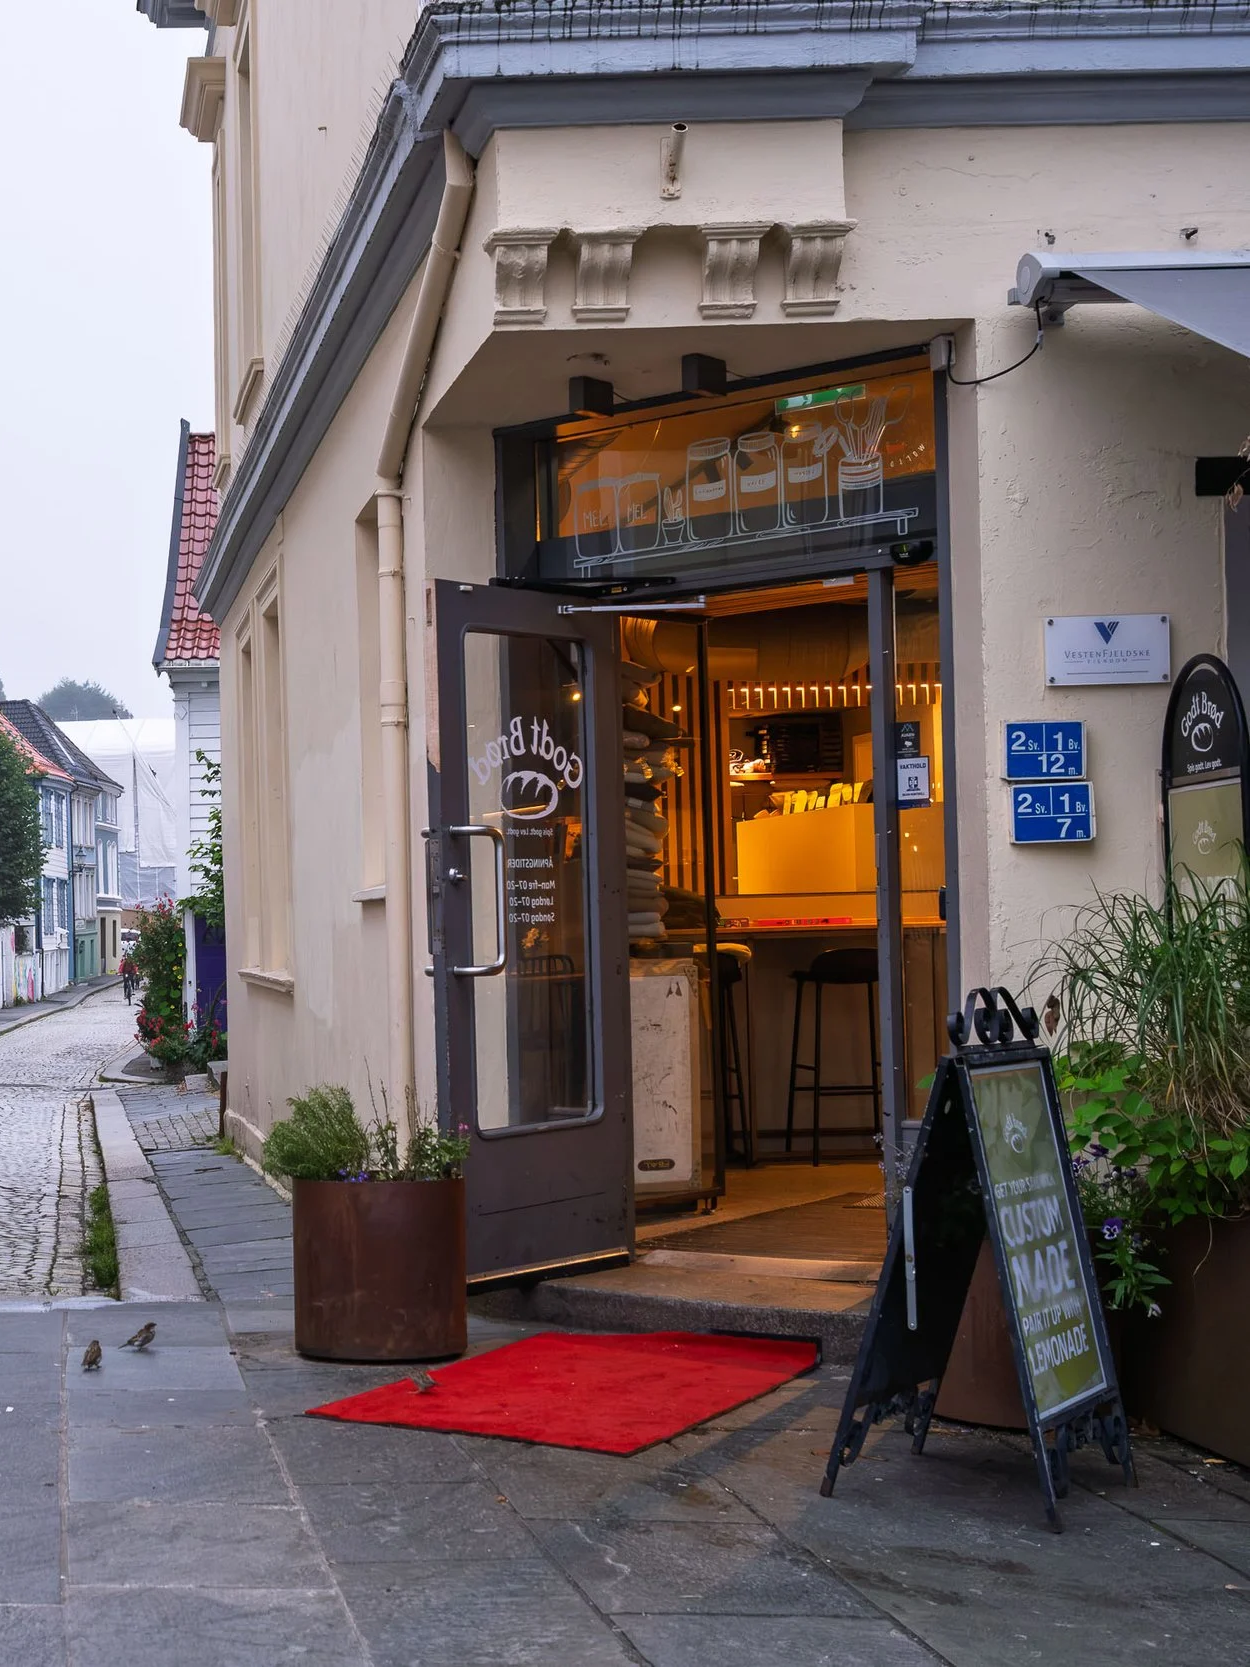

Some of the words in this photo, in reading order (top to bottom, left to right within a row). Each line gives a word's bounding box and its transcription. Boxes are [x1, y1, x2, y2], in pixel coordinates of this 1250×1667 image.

[1181, 692, 1200, 737] Godt
[1201, 691, 1224, 729] Brød
[1011, 731, 1026, 751] 2
[1028, 739, 1040, 751] Sv.
[1053, 731, 1063, 751] 1
[1068, 739, 1081, 750] Bv.
[1037, 753, 1065, 773] 12
[1068, 767, 1079, 775] m.
[1017, 793, 1033, 813] 2
[1035, 803, 1047, 814] Sv.
[1059, 793, 1070, 813] 1
[1075, 801, 1088, 813] Bv.
[1056, 818, 1072, 838] 7
[1076, 830, 1086, 838] m.
[1000, 1195, 1064, 1248] CUSTOM
[1011, 1239, 1076, 1308] MADE
[1022, 1312, 1042, 1337] PAIR
[1042, 1308, 1050, 1328] IT
[1050, 1304, 1062, 1326] UP
[1028, 1323, 1090, 1376] LEMONADE
